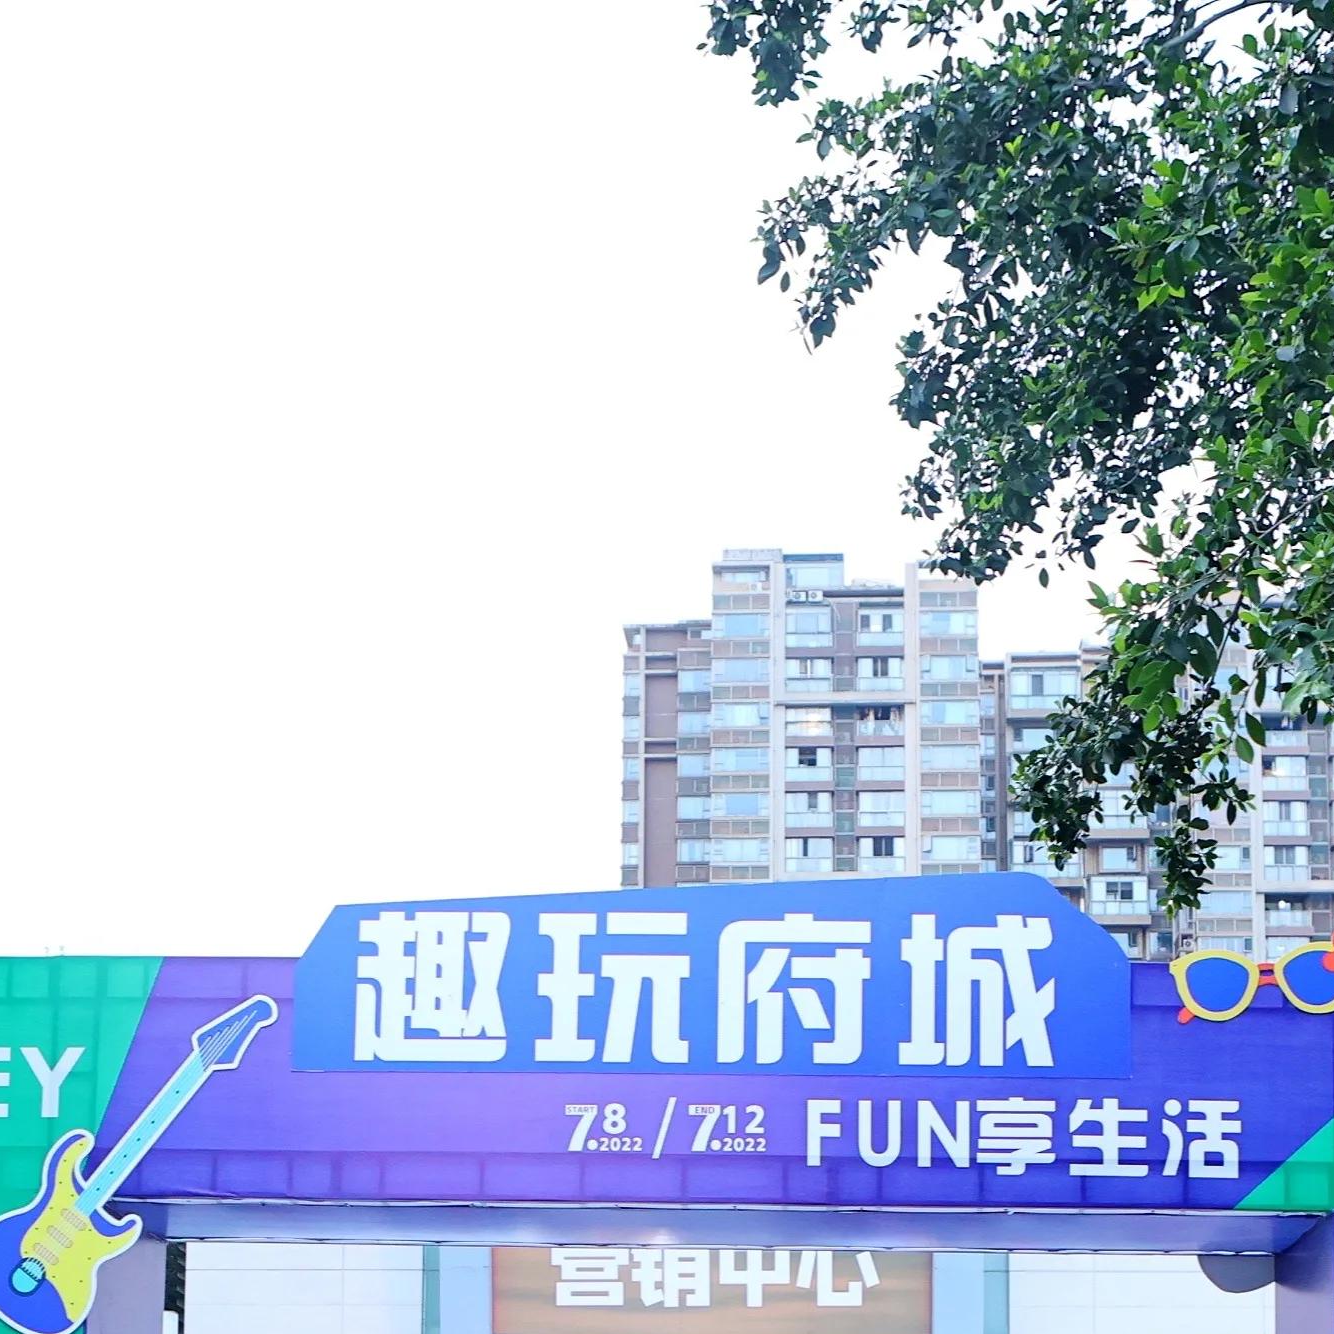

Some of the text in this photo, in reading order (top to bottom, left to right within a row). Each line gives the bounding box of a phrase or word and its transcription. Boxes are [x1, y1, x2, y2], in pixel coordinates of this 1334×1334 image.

[353, 909, 1056, 1068] 趣玩府城
[694, 1106, 716, 1115] END
[805, 1097, 1244, 1180] FUN享生活
